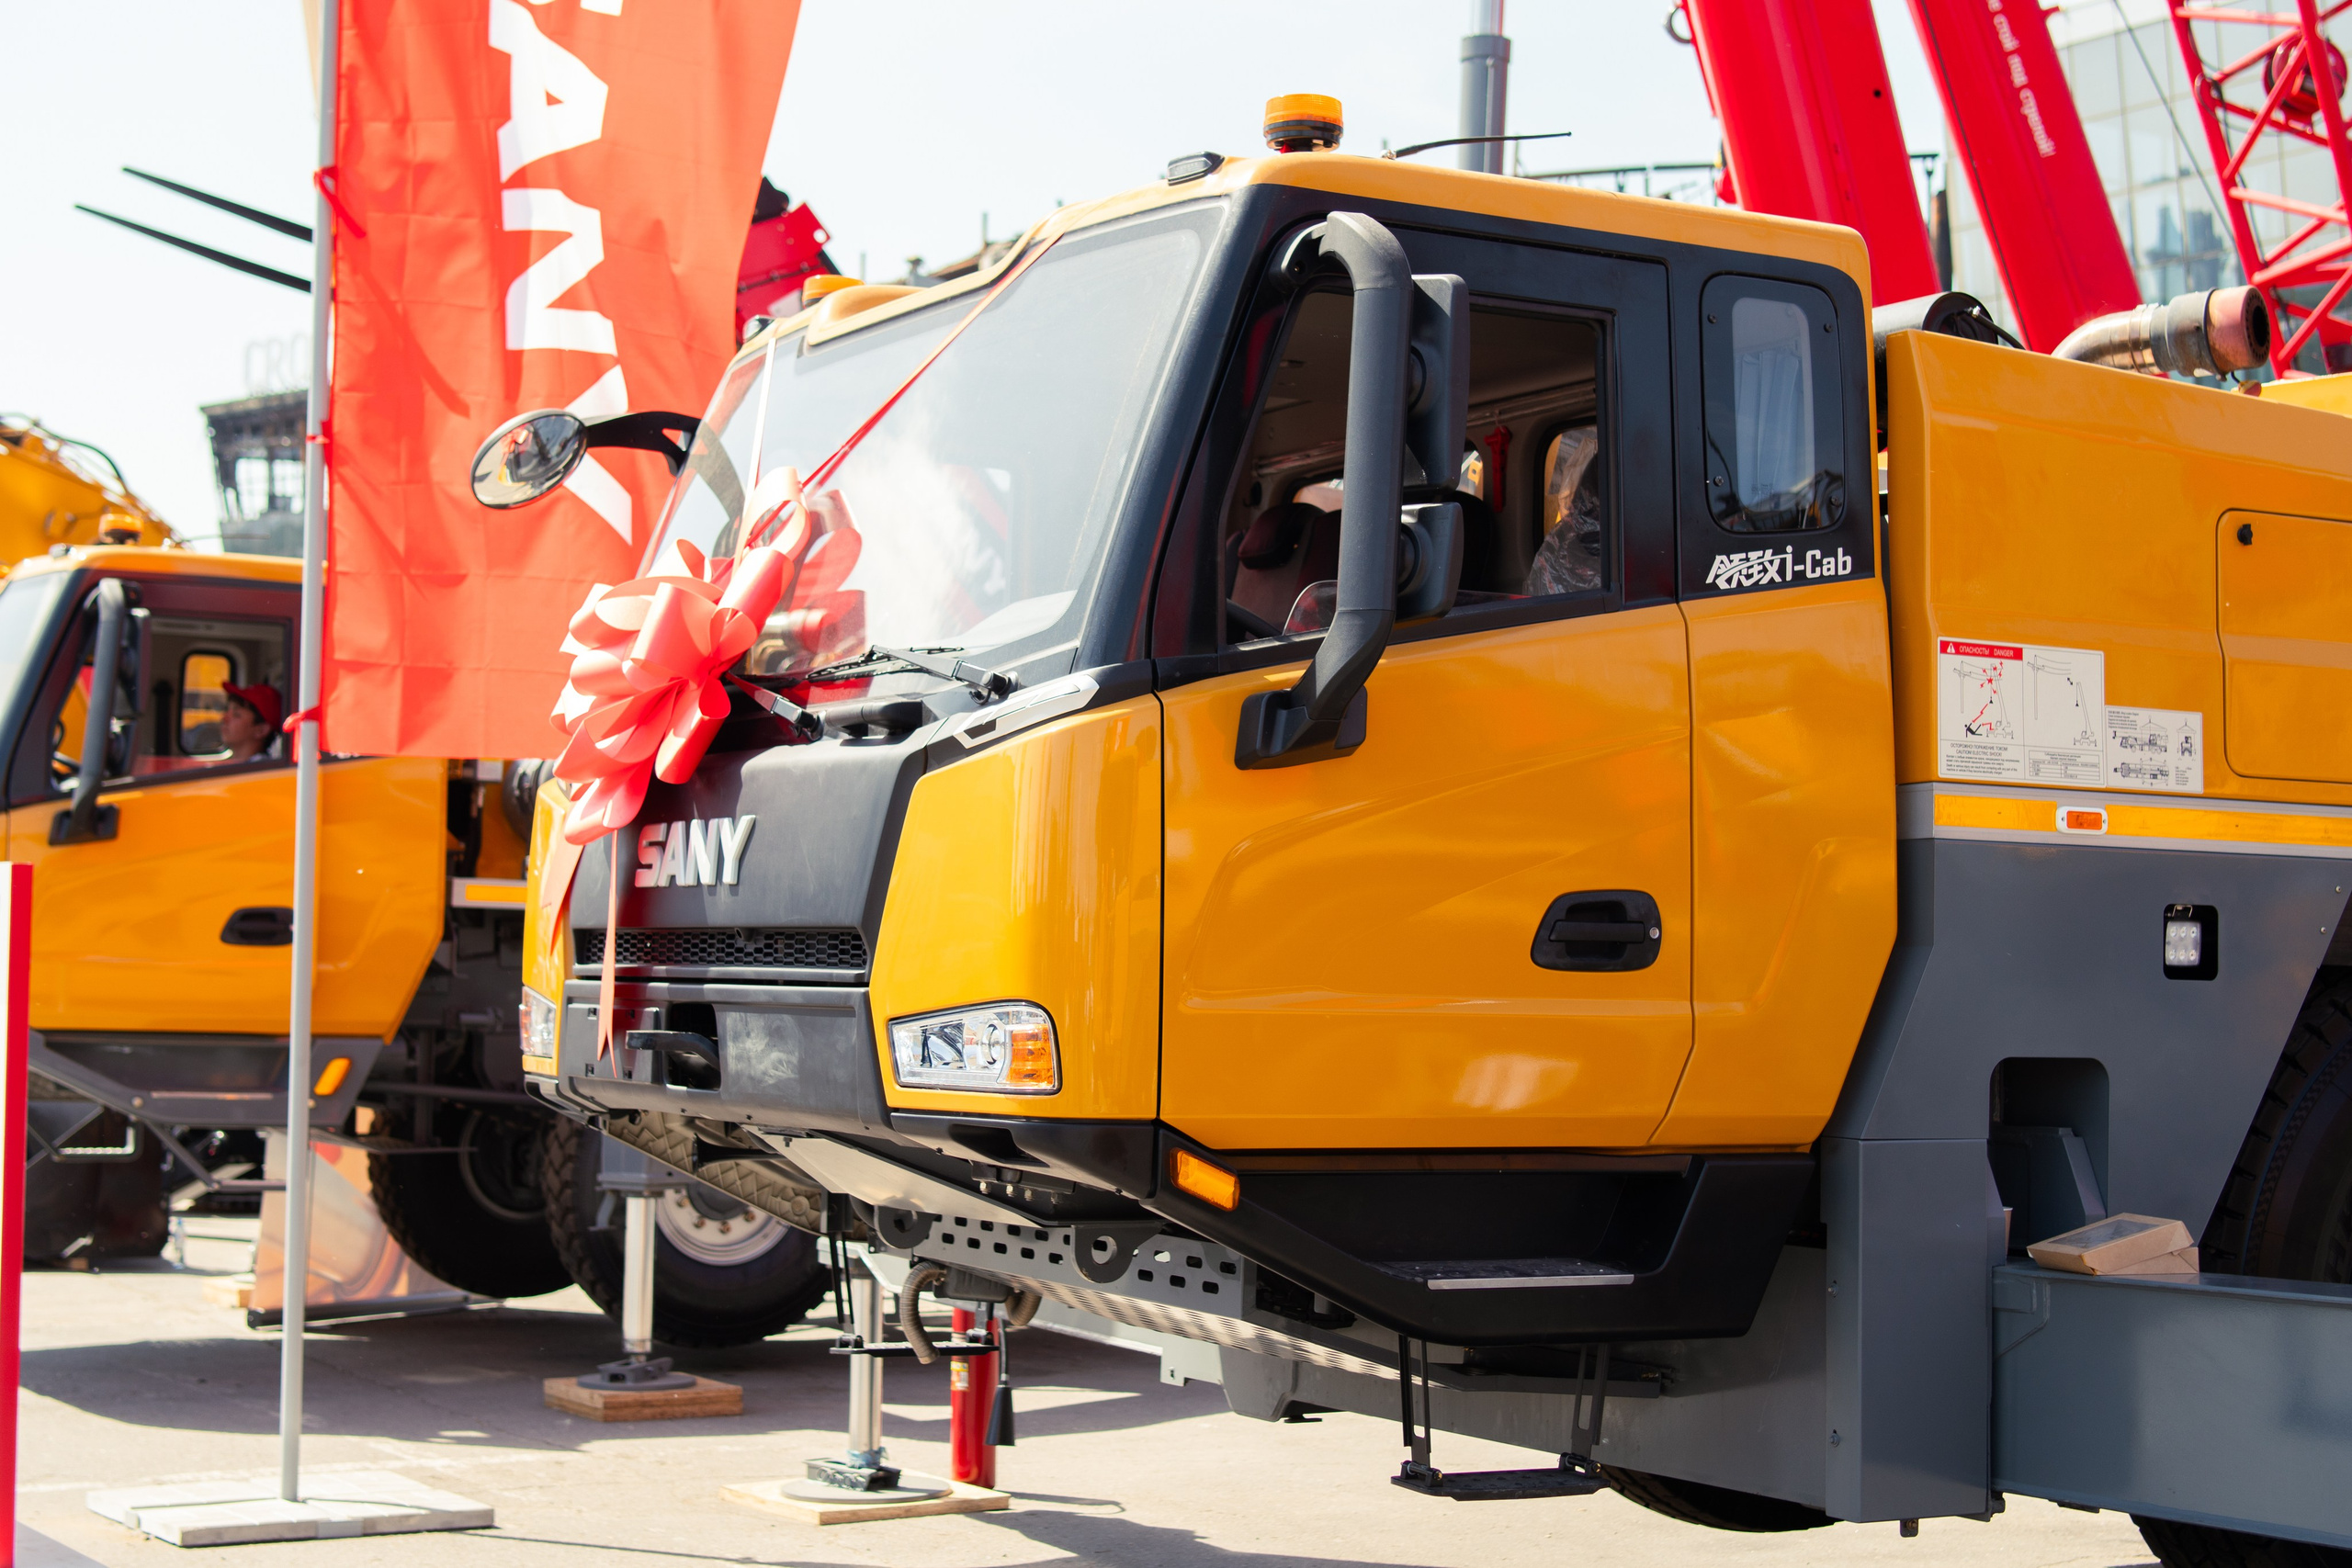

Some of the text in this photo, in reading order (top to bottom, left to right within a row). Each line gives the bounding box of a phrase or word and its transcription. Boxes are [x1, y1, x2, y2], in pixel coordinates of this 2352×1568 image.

[488, 0, 633, 546] ANY
[1993, 648, 2014, 658] DANGER
[634, 815, 756, 887] SANY
